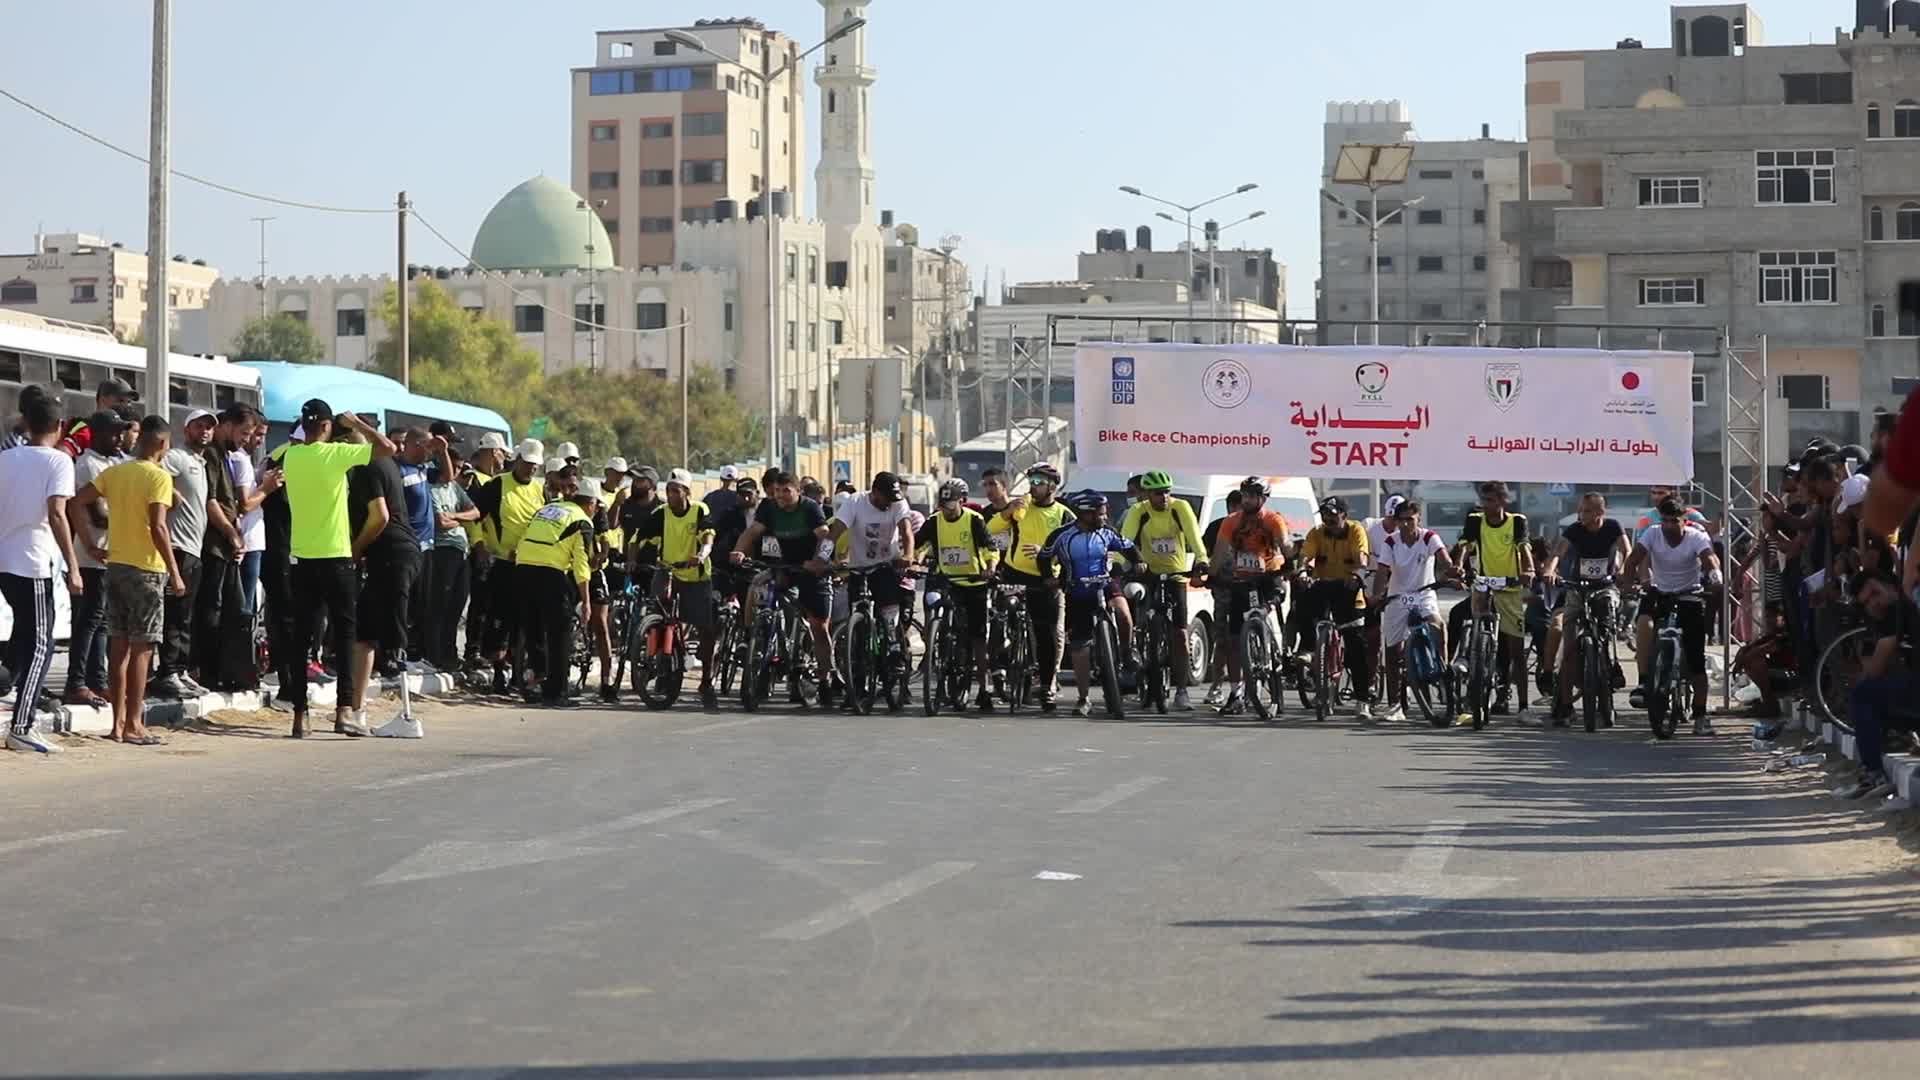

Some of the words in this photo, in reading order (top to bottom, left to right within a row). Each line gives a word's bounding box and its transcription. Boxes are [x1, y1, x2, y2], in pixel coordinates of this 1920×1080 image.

[1289, 400, 1430, 438] البداية
[1099, 430, 1128, 442] Bike
[1132, 430, 1167, 443] Race
[1170, 431, 1271, 449] Championship
[1539, 436, 1604, 455] الدراجات
[1609, 438, 1659, 456] بطولة
[1310, 441, 1409, 467] START
